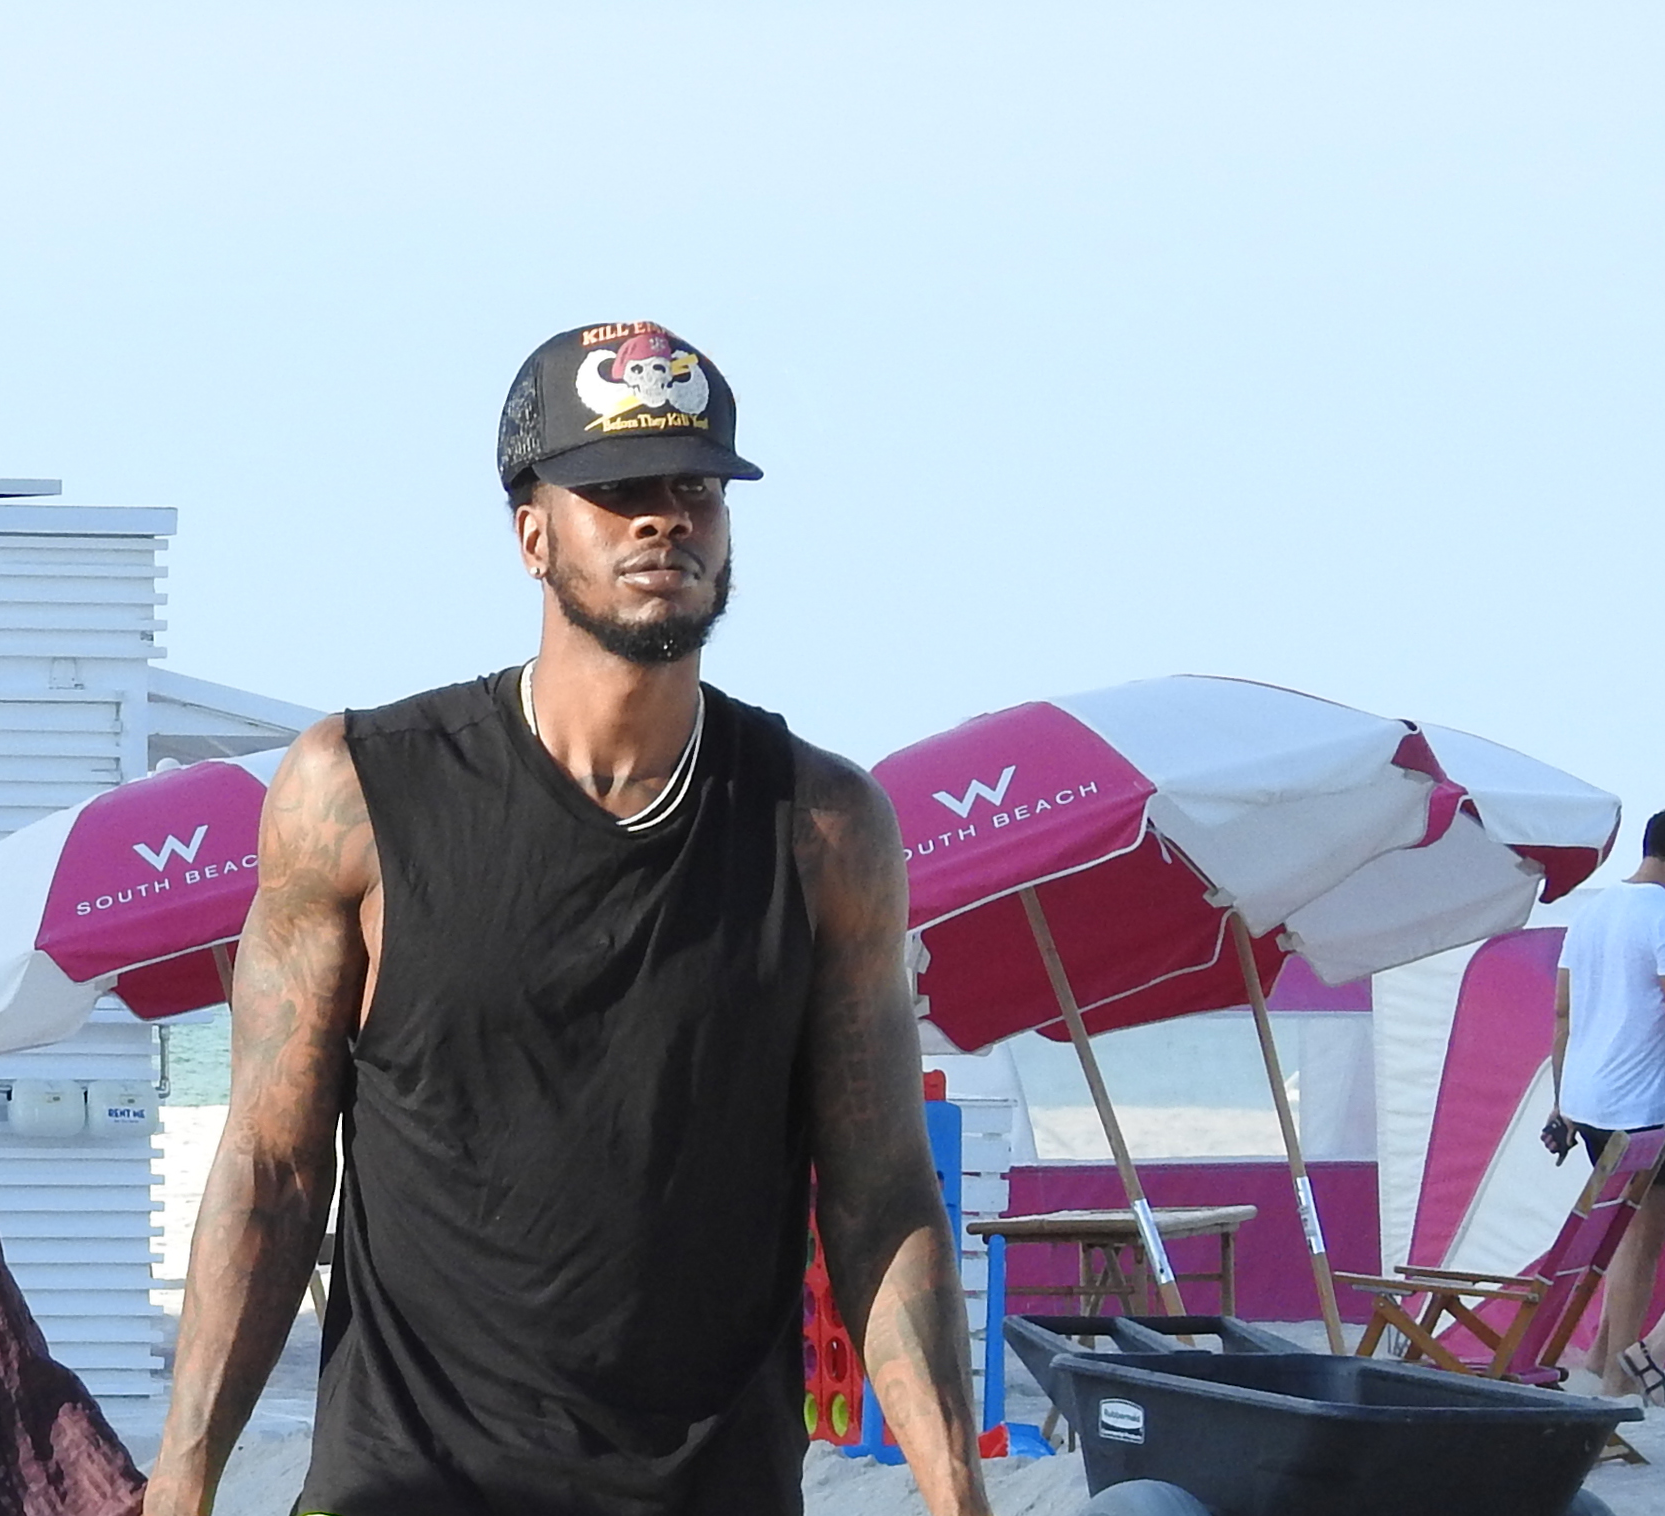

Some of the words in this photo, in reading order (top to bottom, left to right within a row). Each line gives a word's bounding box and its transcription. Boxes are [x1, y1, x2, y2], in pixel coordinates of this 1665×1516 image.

[582, 323, 629, 346] KILL
[637, 414, 666, 430] They
[932, 765, 1016, 818] W
[902, 824, 976, 862] OUTH
[992, 781, 1098, 828] BEACH
[133, 824, 209, 872] W
[76, 878, 170, 915] SOUTH
[185, 854, 258, 885] BEAC
[108, 1108, 130, 1118] RENT
